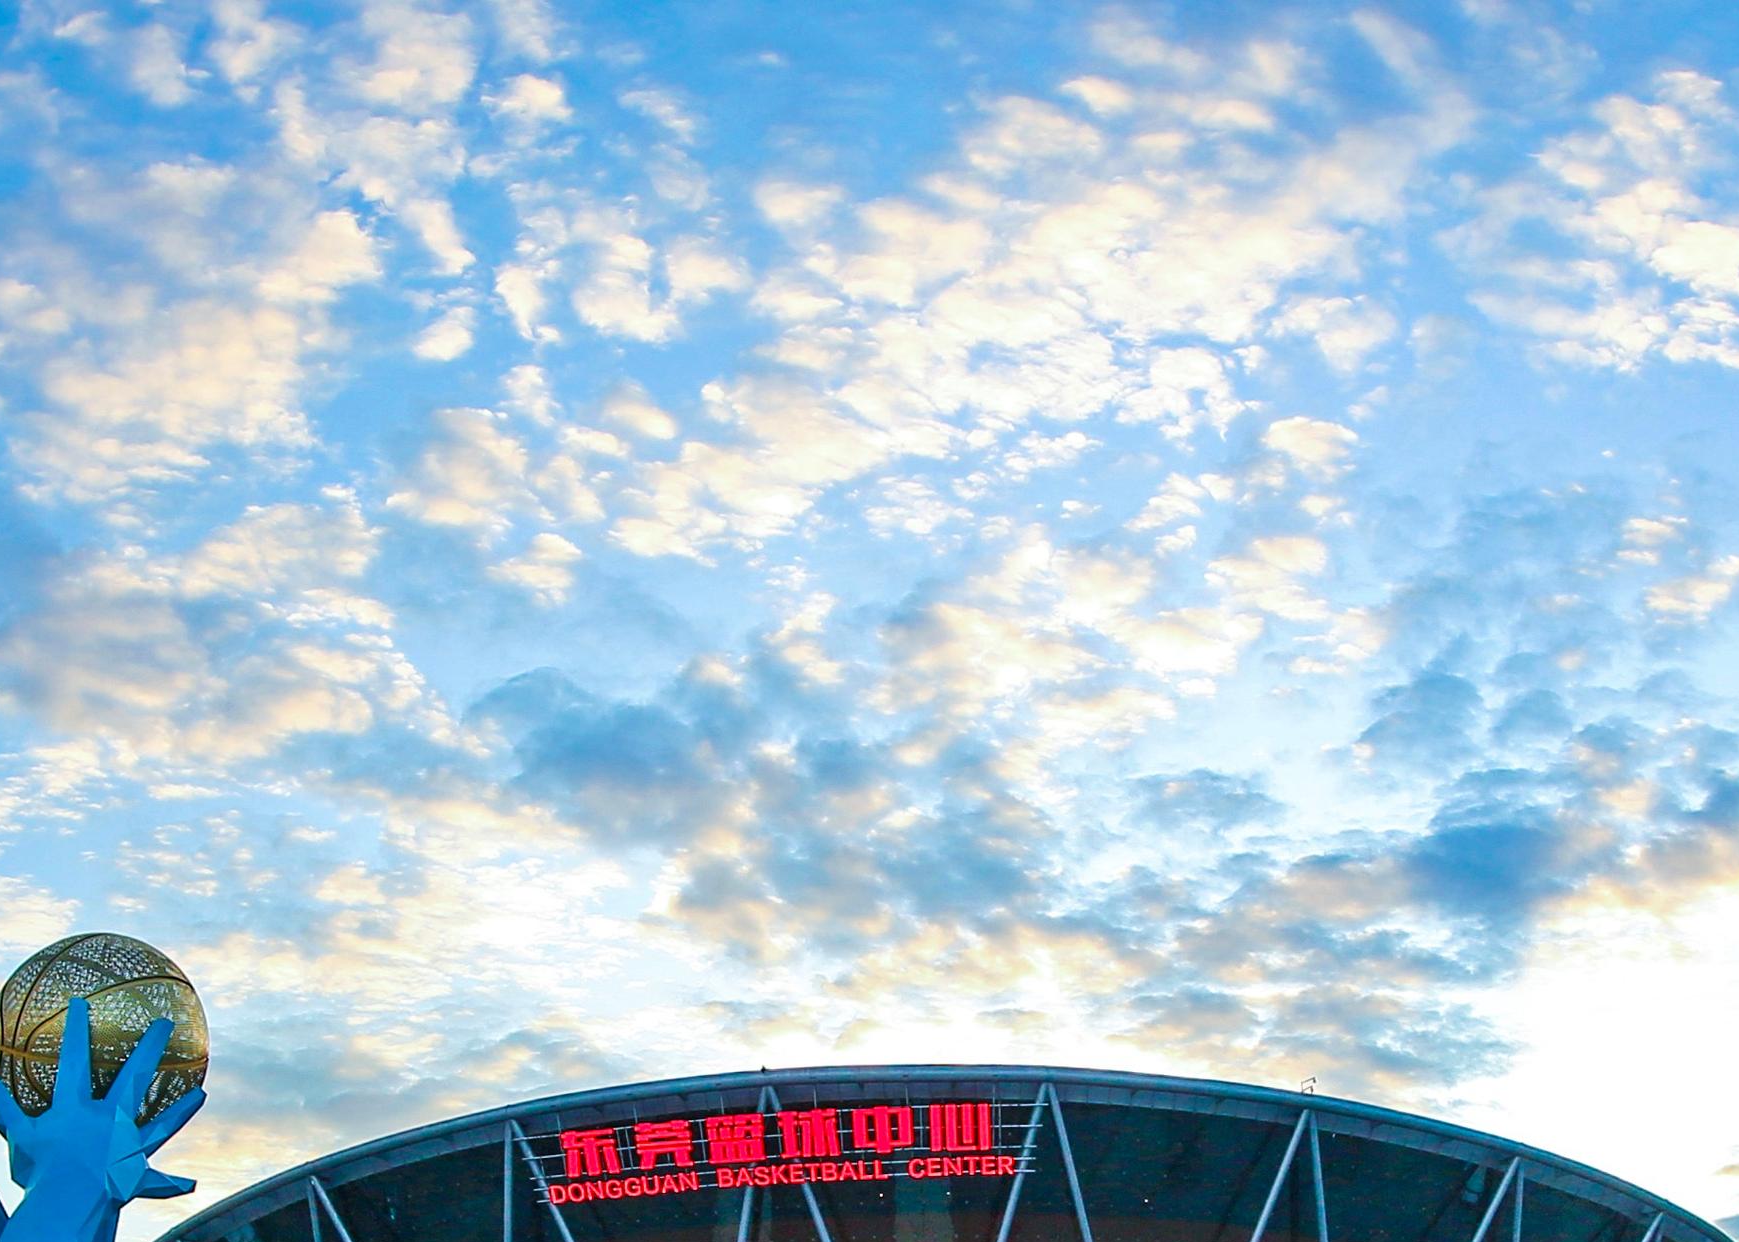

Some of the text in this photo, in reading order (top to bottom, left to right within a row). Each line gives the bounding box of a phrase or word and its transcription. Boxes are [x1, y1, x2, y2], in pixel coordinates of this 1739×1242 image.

[561, 1103, 992, 1178] 东莞篮球中心
[548, 1155, 1016, 1205] DONGGUAN BASKETBALL CENTER
